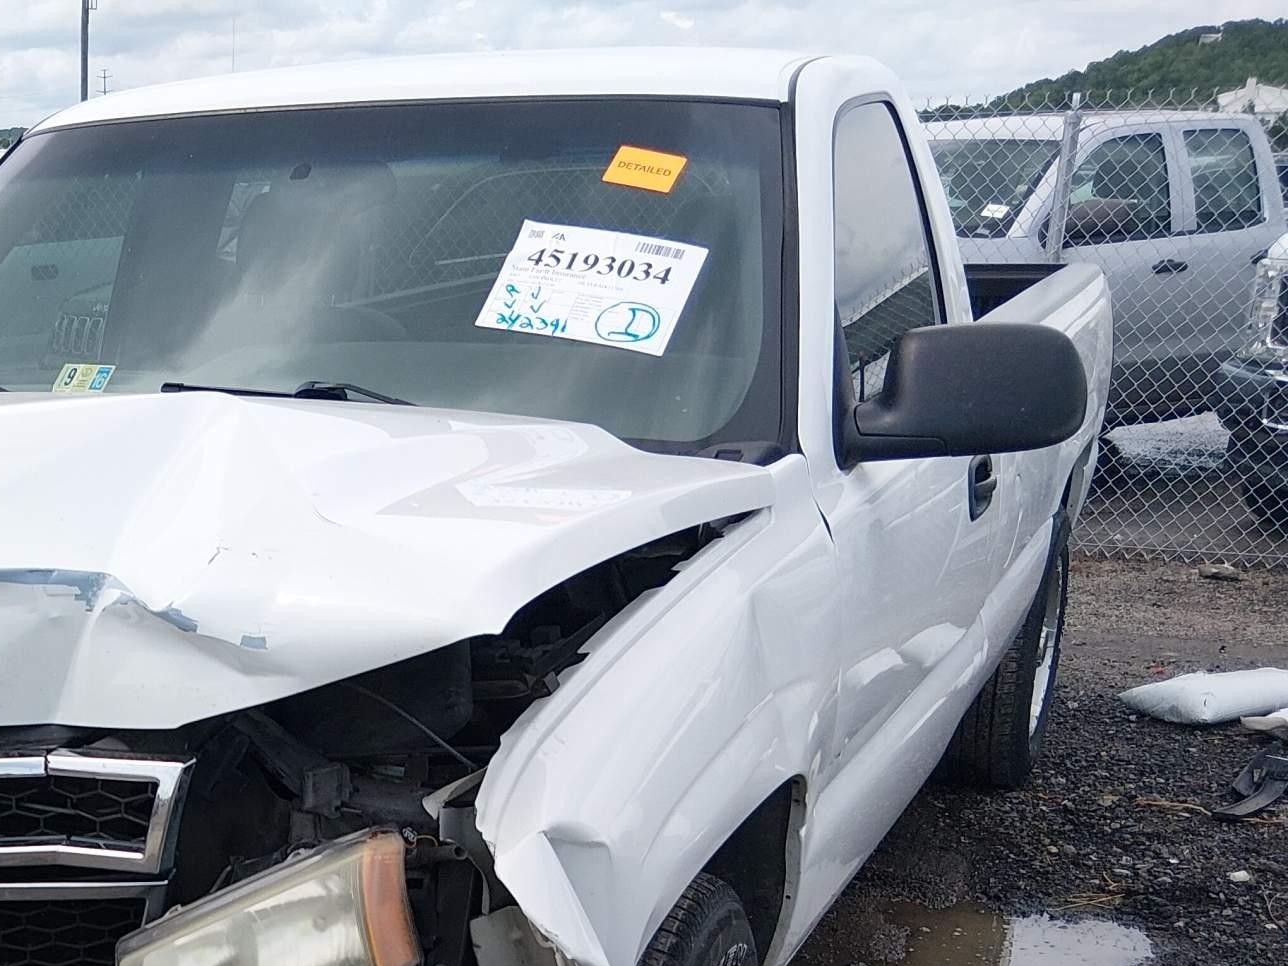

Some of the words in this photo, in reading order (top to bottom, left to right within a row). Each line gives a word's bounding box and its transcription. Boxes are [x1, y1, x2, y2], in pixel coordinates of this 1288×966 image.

[617, 160, 672, 177] DETAILED
[527, 247, 673, 285] 45193034
[64, 367, 78, 386] 9
[92, 373, 107, 388] 16
